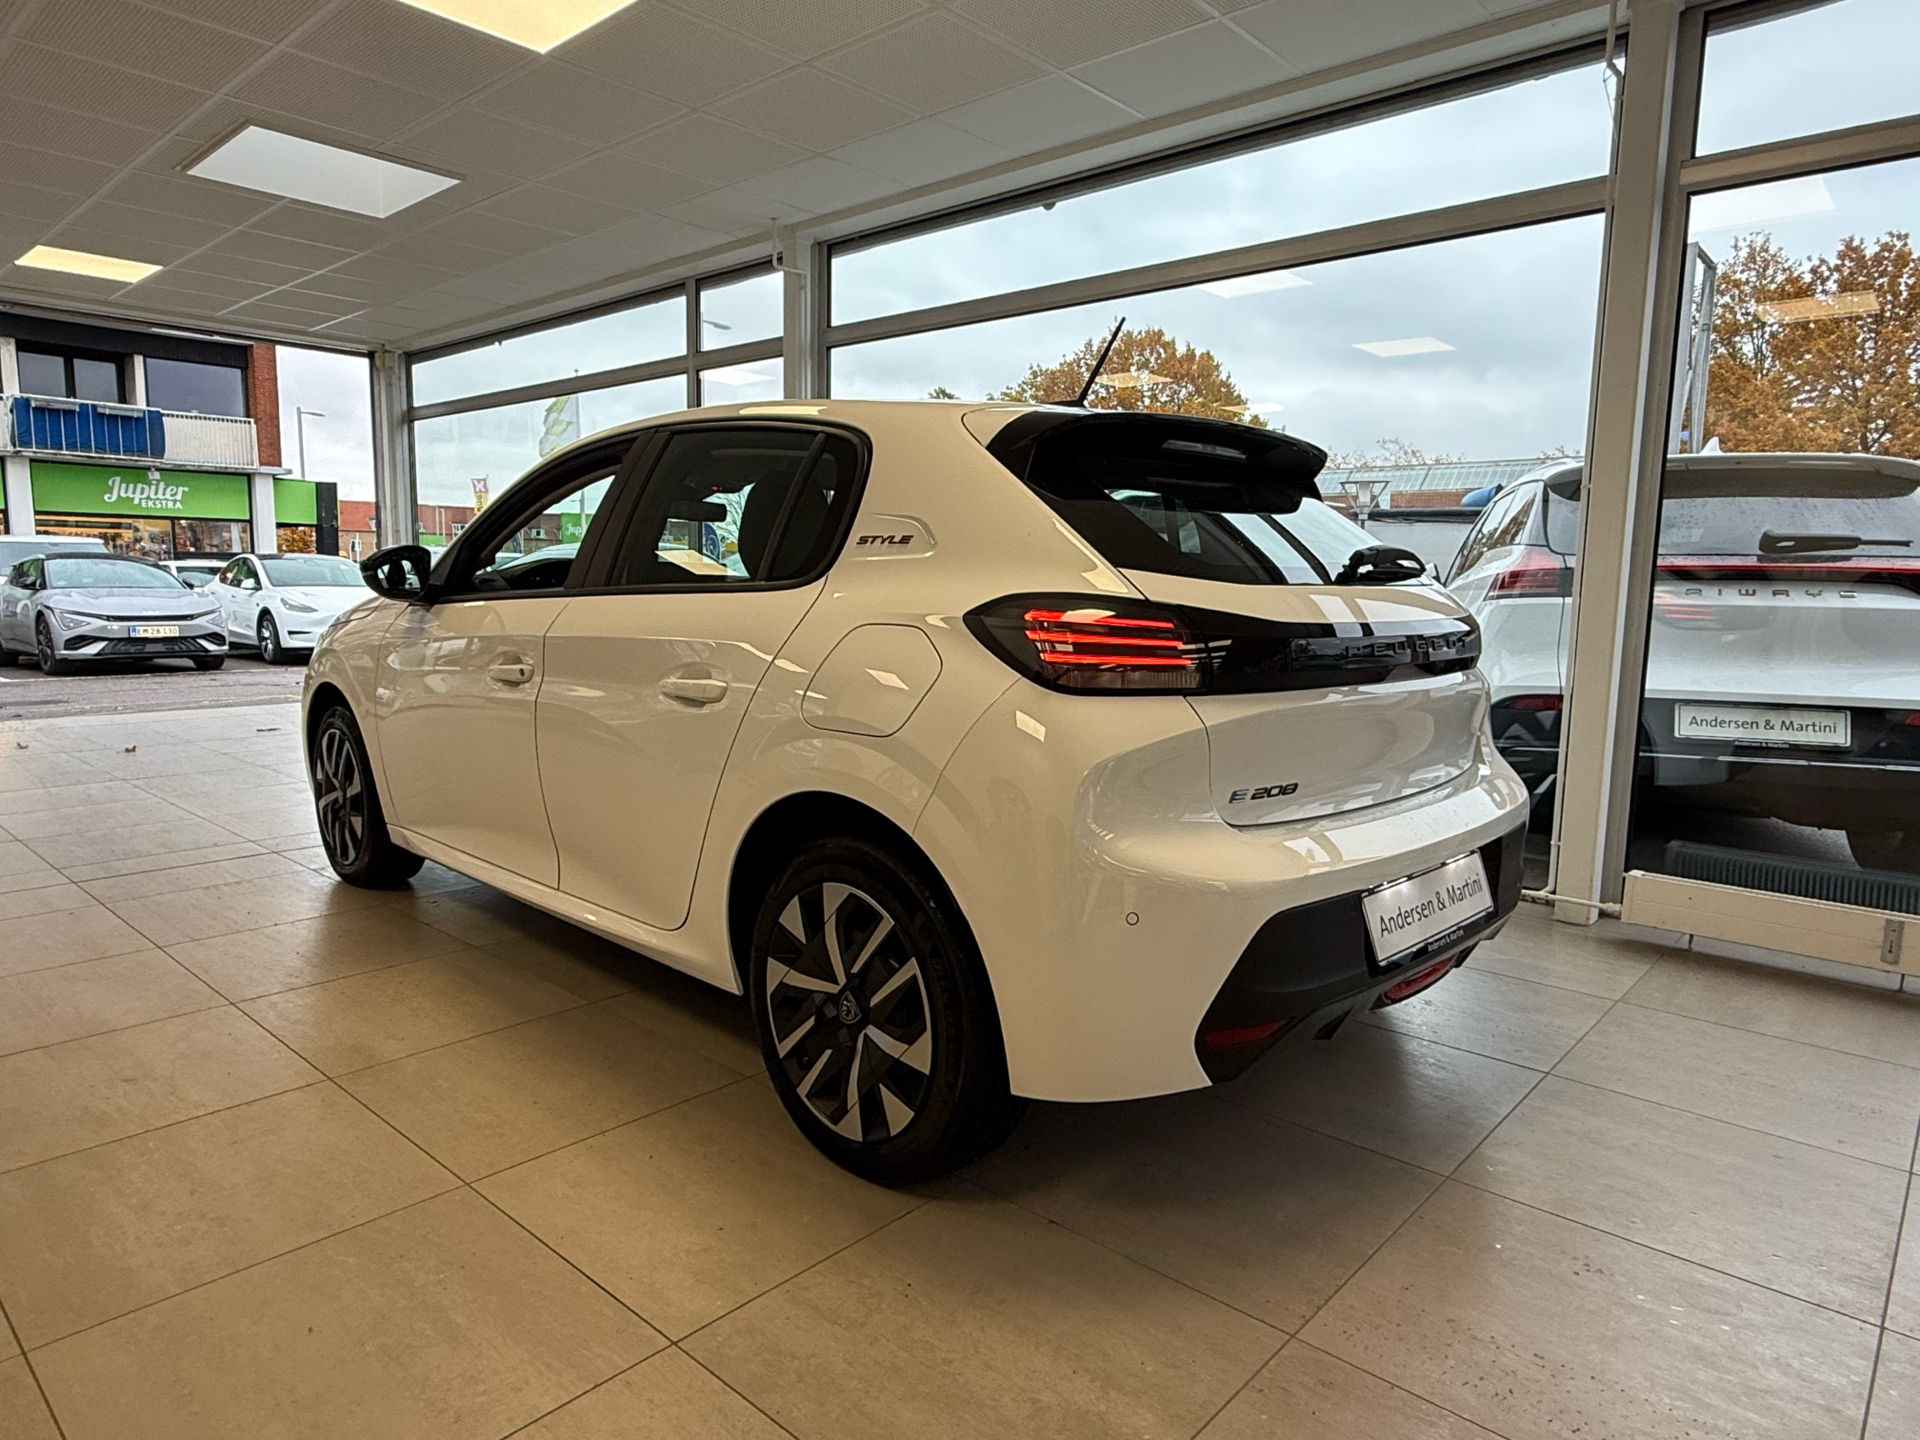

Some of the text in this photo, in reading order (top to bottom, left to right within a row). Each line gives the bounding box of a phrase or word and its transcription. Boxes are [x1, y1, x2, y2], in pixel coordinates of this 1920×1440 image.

[103, 476, 189, 505] Jupiter
[141, 500, 183, 510] EKSTRA
[856, 535, 914, 545] STYLE
[1685, 588, 1858, 599] AIWAYS
[1346, 637, 1467, 657] PEUGEOT
[1688, 715, 1837, 734] Andersen & Martini
[1228, 782, 1298, 803] E 208
[1379, 873, 1483, 938] Andersen & Martini
